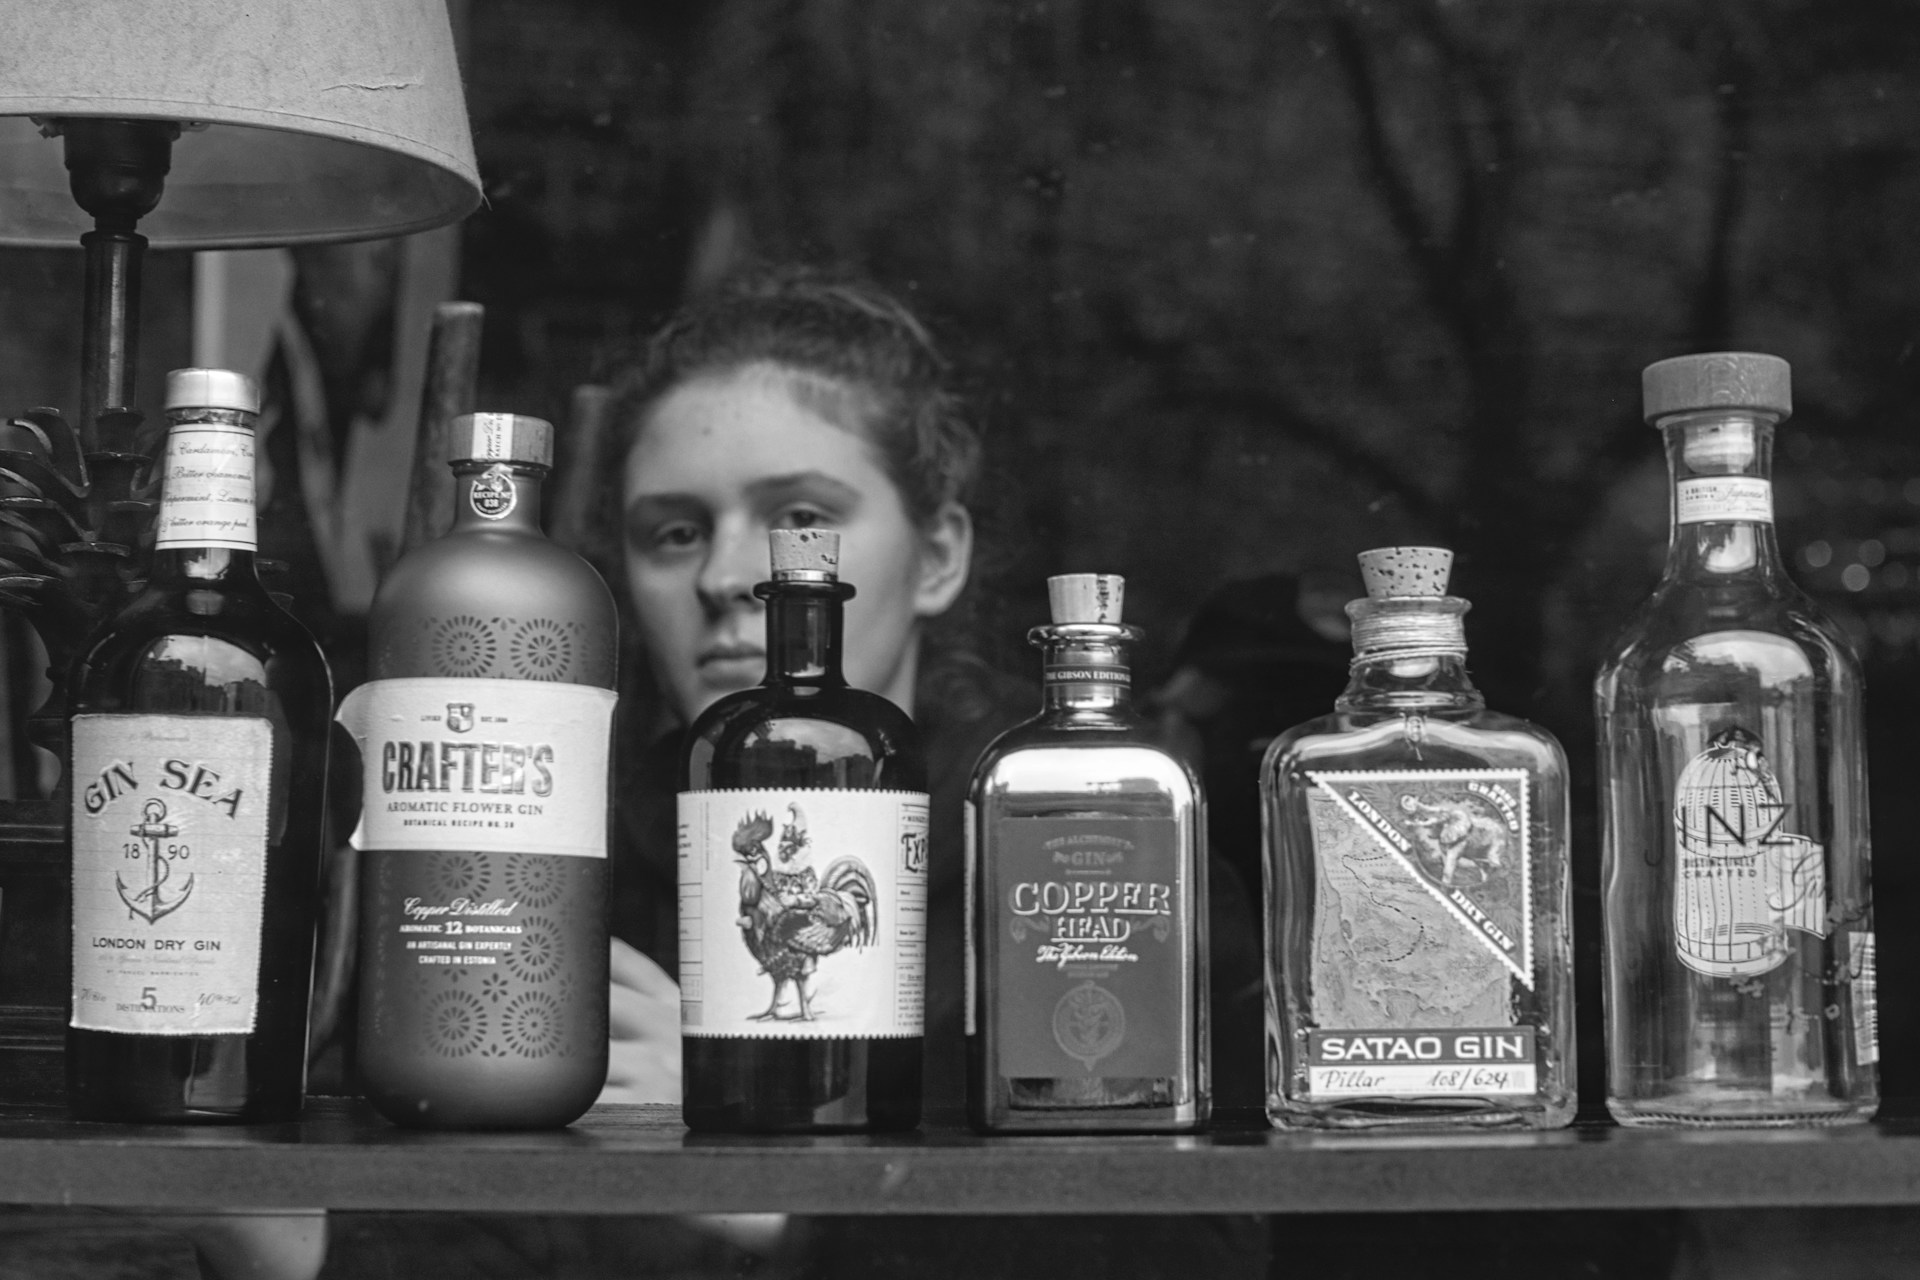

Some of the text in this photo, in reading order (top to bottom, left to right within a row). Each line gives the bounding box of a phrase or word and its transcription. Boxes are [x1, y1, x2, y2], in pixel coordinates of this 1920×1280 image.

[1057, 671, 1092, 680] GIBSON
[383, 741, 555, 798] CRAFTER'S
[84, 760, 243, 820] GIN SEA
[387, 802, 544, 816] AROMATIC FLOWER GIN
[403, 819, 446, 827] BOTANICAL
[452, 820, 483, 828] RECIPE
[1347, 790, 1412, 852] LONDON
[122, 843, 190, 861] 18 90
[1071, 851, 1106, 866] GIN
[1683, 869, 1757, 878] CRAFTED
[404, 897, 519, 920] Copper Distilled
[1009, 882, 1171, 916] COPPER
[445, 920, 463, 935] 12
[465, 925, 522, 934] BOTANICALS
[1051, 916, 1131, 942] HEAD
[1450, 889, 1515, 951] DRY GIN
[92, 937, 221, 952] LONDON DRY GIN
[475, 941, 512, 950] EXPERTLY
[418, 955, 451, 964] CRAFTED
[463, 955, 497, 964] ESTONIA
[140, 987, 158, 1010] 5
[1321, 1036, 1523, 1060] SATAO GIN
[1320, 1069, 1385, 1089] Pillar
